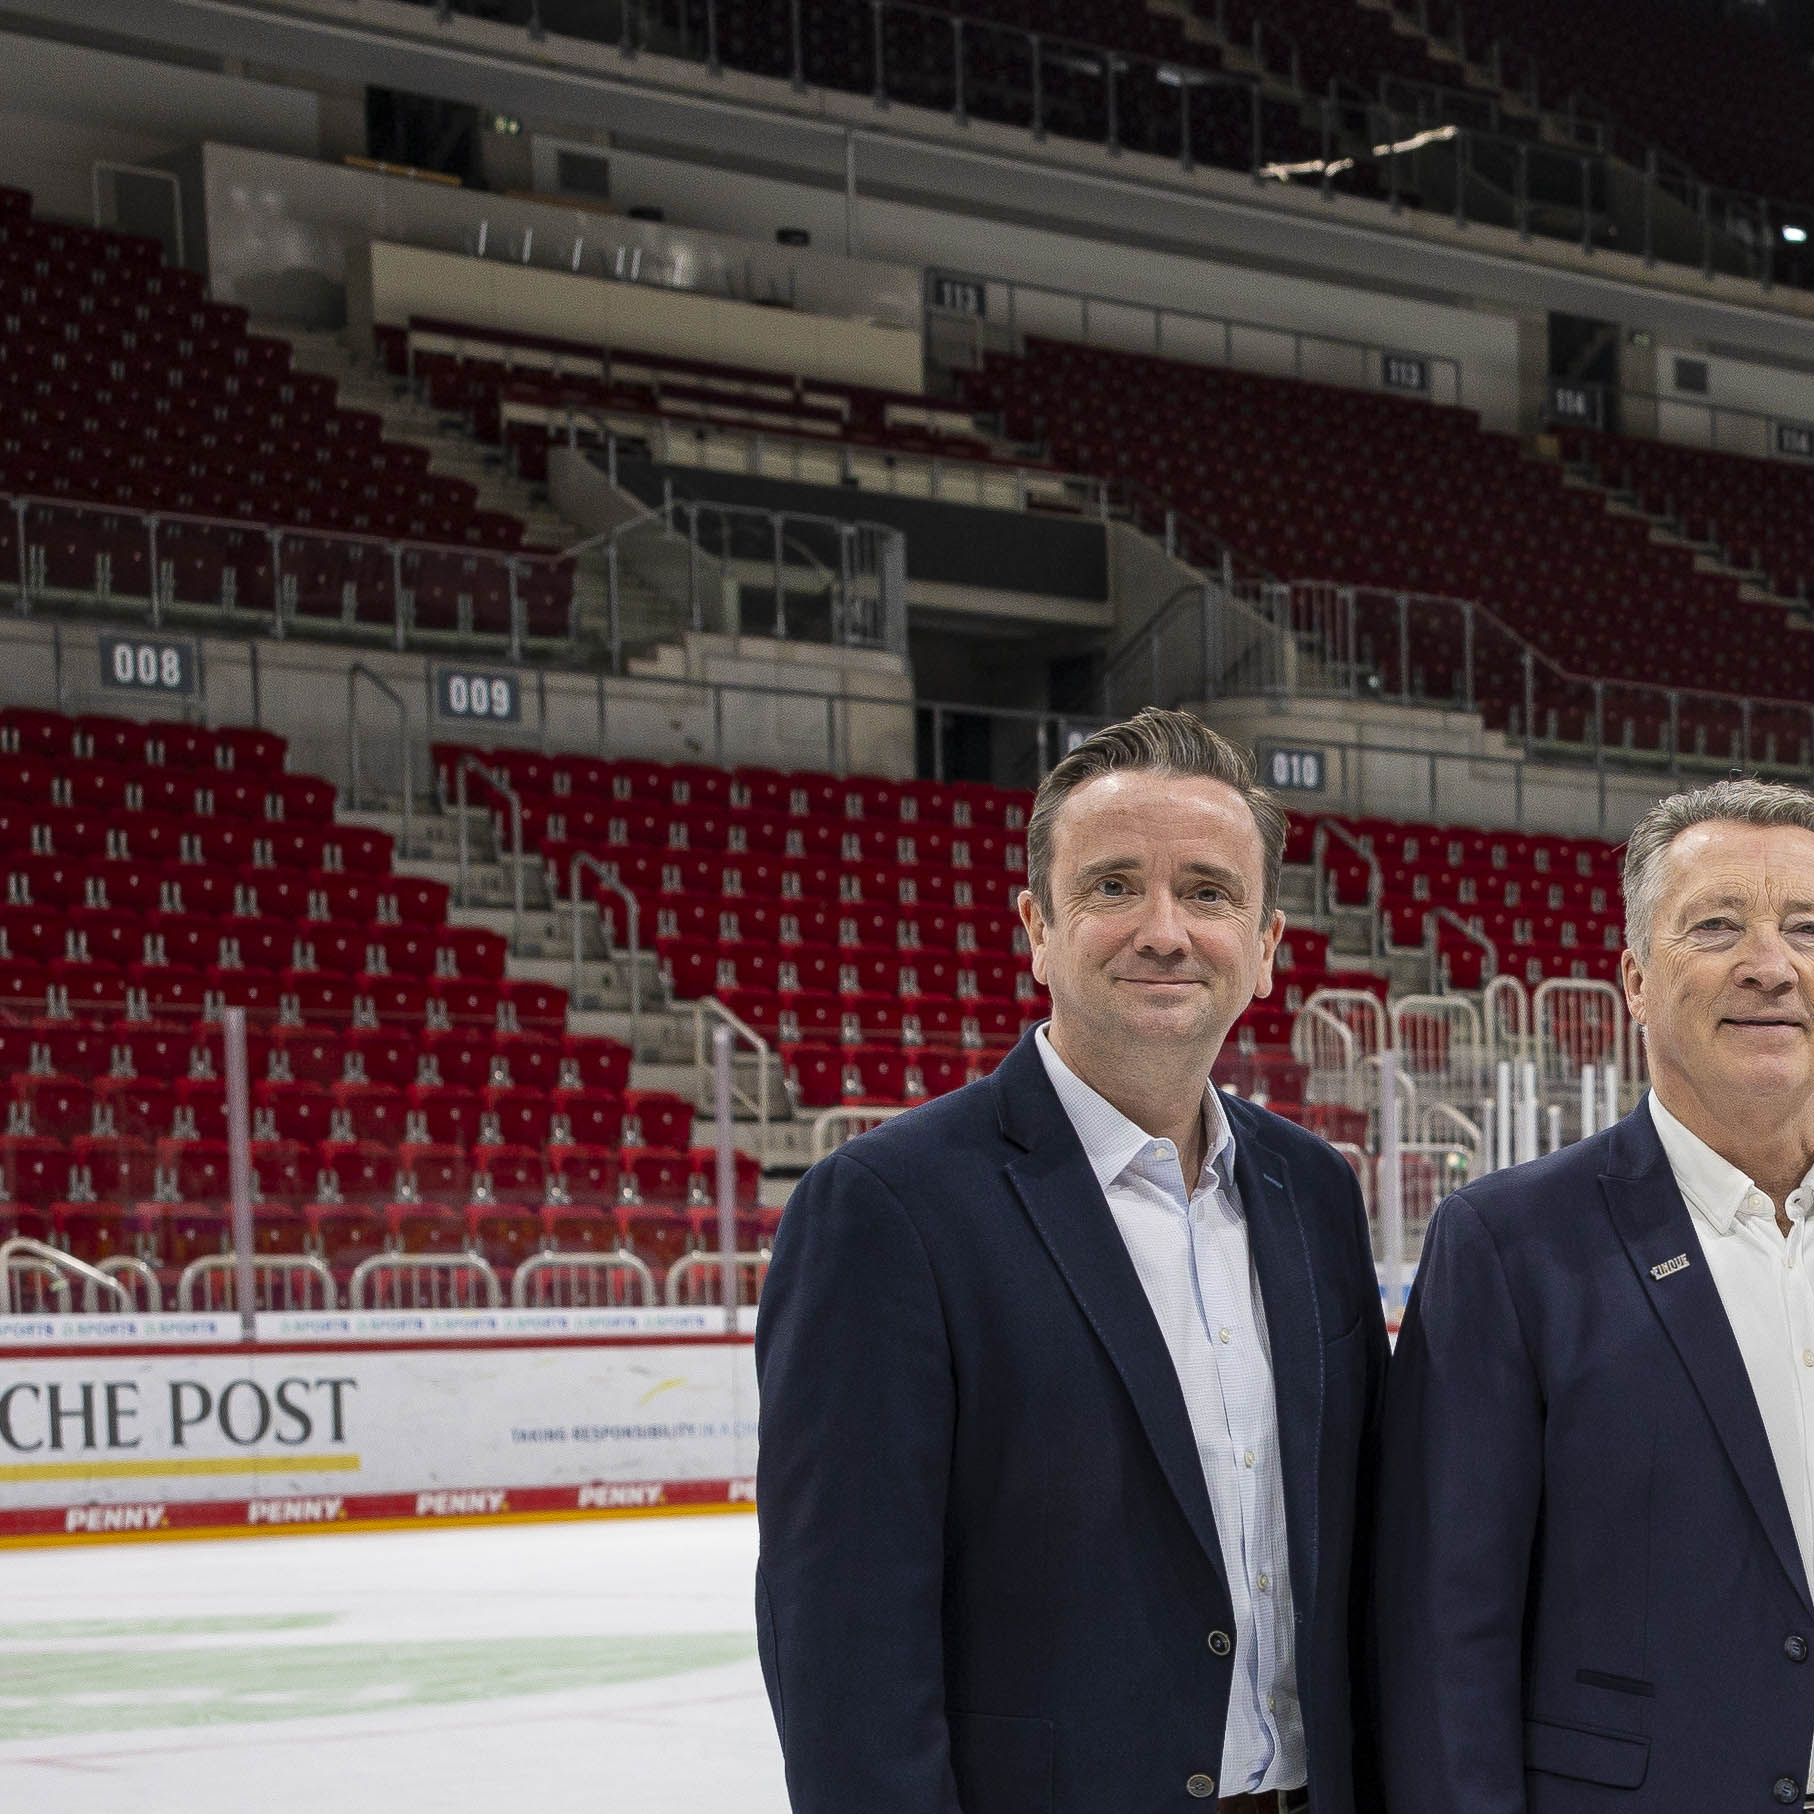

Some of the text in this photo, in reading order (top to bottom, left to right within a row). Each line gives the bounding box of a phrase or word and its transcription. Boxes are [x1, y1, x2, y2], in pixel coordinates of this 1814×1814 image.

[113, 643, 181, 688] 008
[448, 674, 511, 718] 009
[1272, 752, 1318, 788] 010
[0, 1376, 359, 1451] CHE POST
